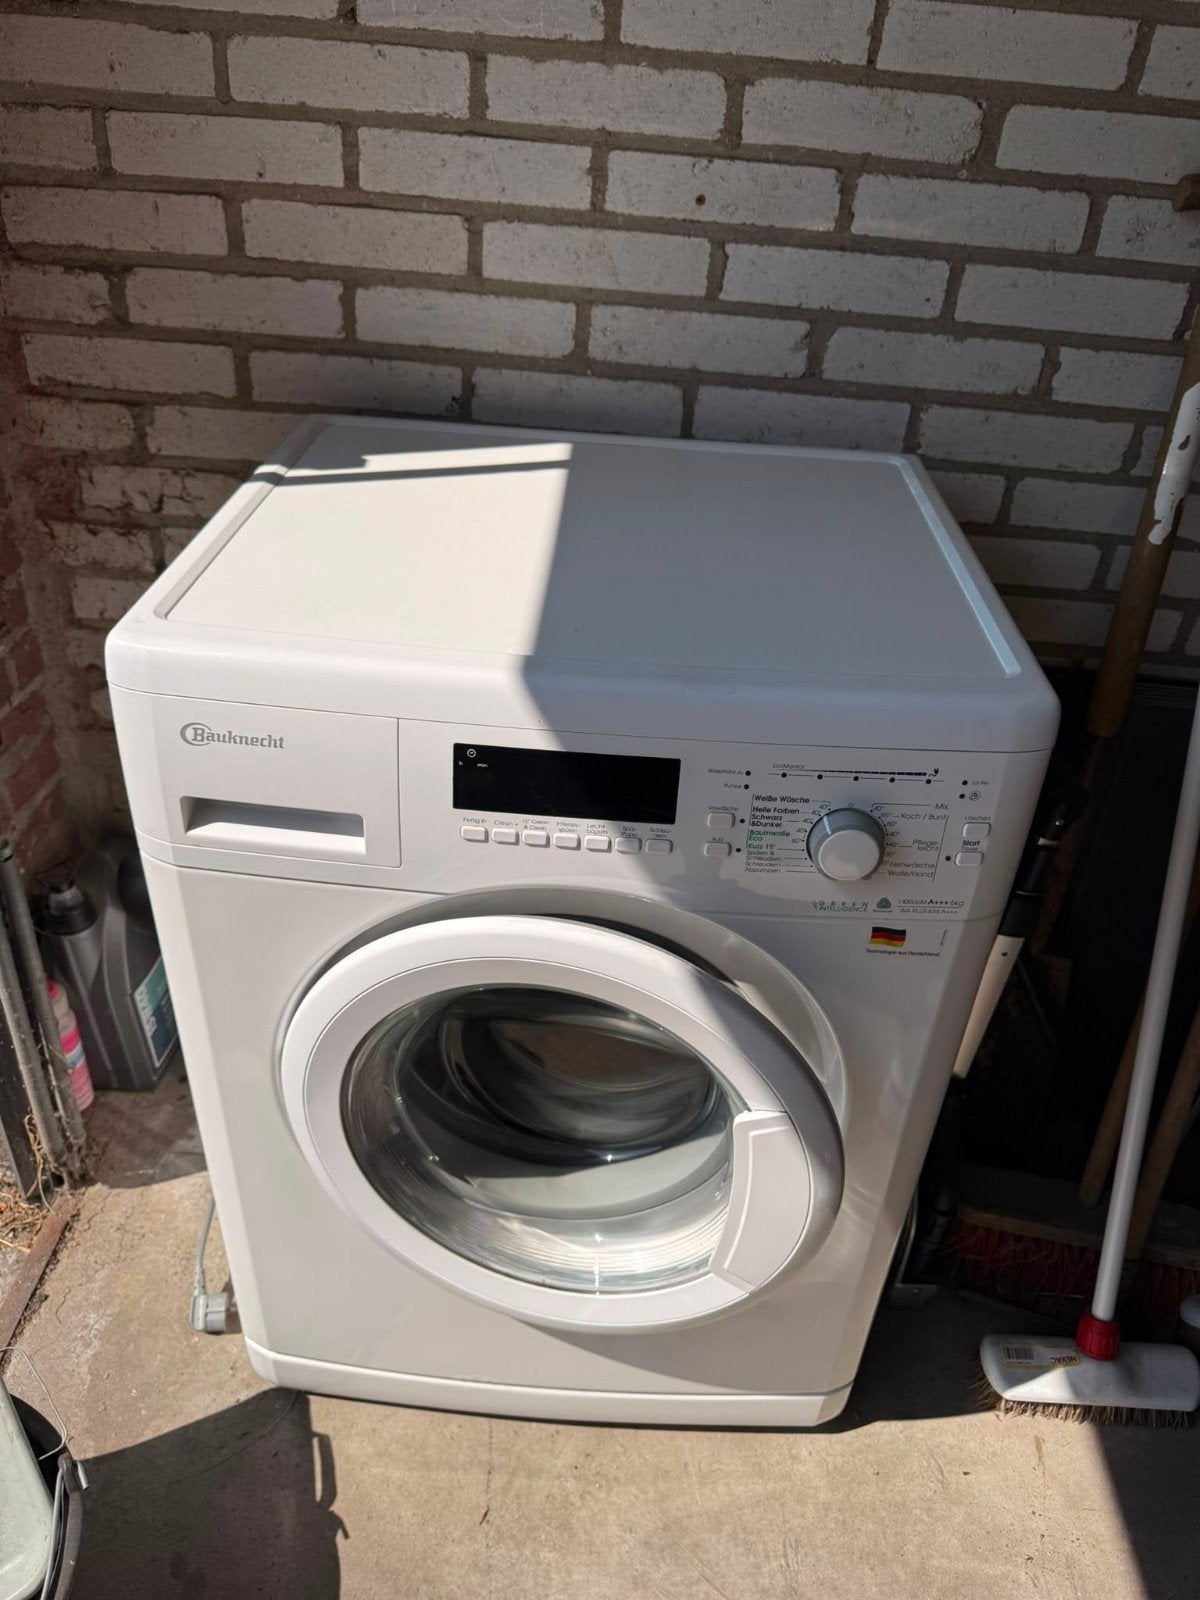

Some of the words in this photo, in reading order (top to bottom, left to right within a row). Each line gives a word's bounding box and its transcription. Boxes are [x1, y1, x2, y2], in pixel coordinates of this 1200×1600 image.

[184, 724, 285, 749] Bauknecht
[754, 794, 778, 803] Weiße
[779, 796, 810, 804] Wäsche
[773, 807, 800, 815] Farben
[463, 816, 480, 825] Fertig
[751, 813, 783, 821] Schwarz
[928, 813, 947, 821] Bunt
[749, 829, 791, 837] Baumwolle
[961, 839, 981, 847] Start
[745, 860, 781, 868] Schleudern
[889, 861, 935, 870] Feinwäsche
[744, 866, 781, 874] Abpumpen
[887, 869, 934, 878] Wolle/Hand
[865, 948, 897, 956] Technologie
[908, 950, 940, 958] Deutschland
